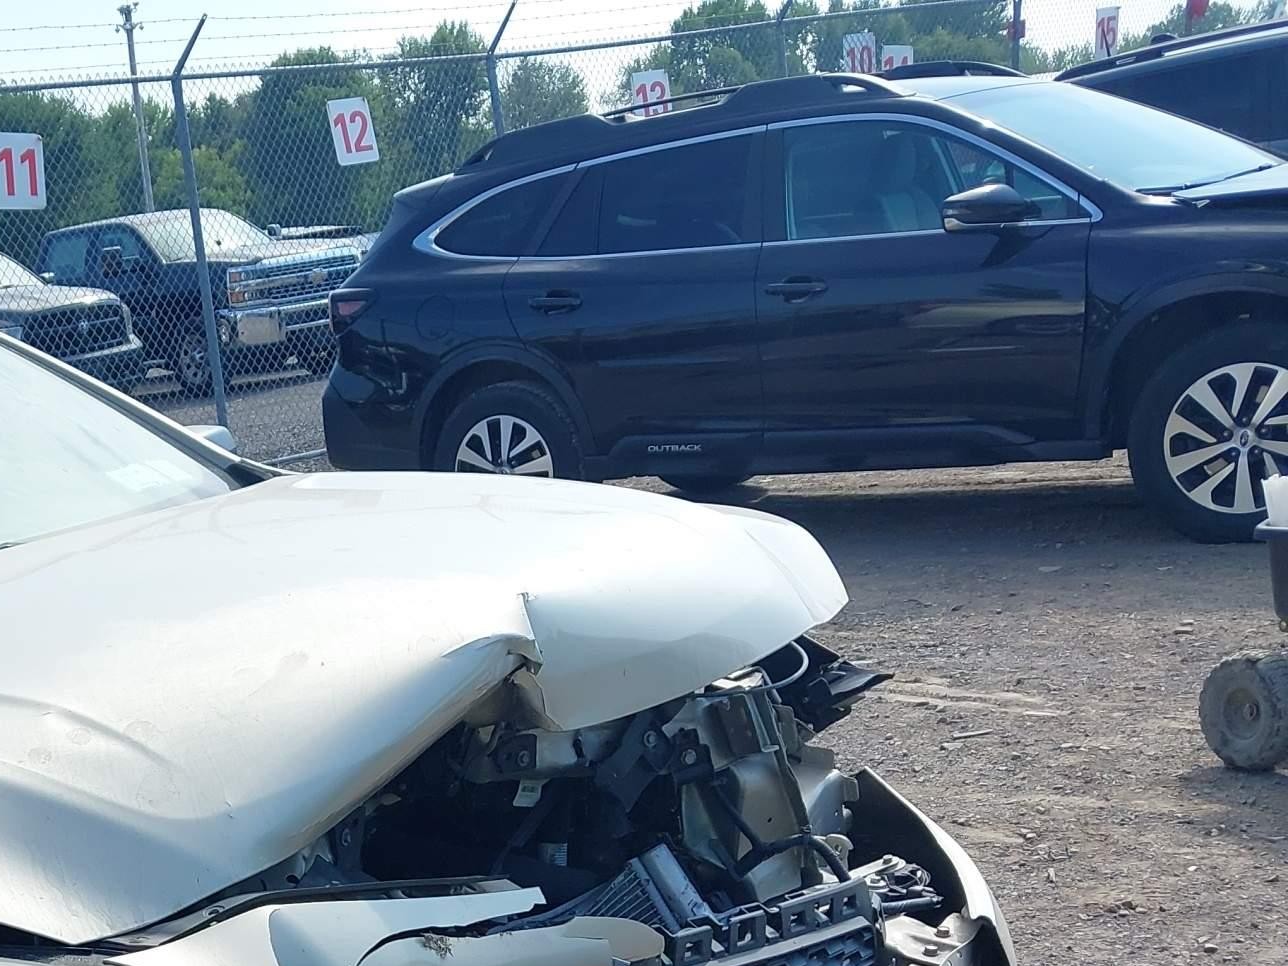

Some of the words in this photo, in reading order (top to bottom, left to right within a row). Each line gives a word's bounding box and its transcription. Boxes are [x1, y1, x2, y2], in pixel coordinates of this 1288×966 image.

[1097, 16, 1116, 49] 15
[635, 81, 669, 117] 13
[333, 110, 374, 154] 12
[647, 444, 703, 453] OUTBACK
